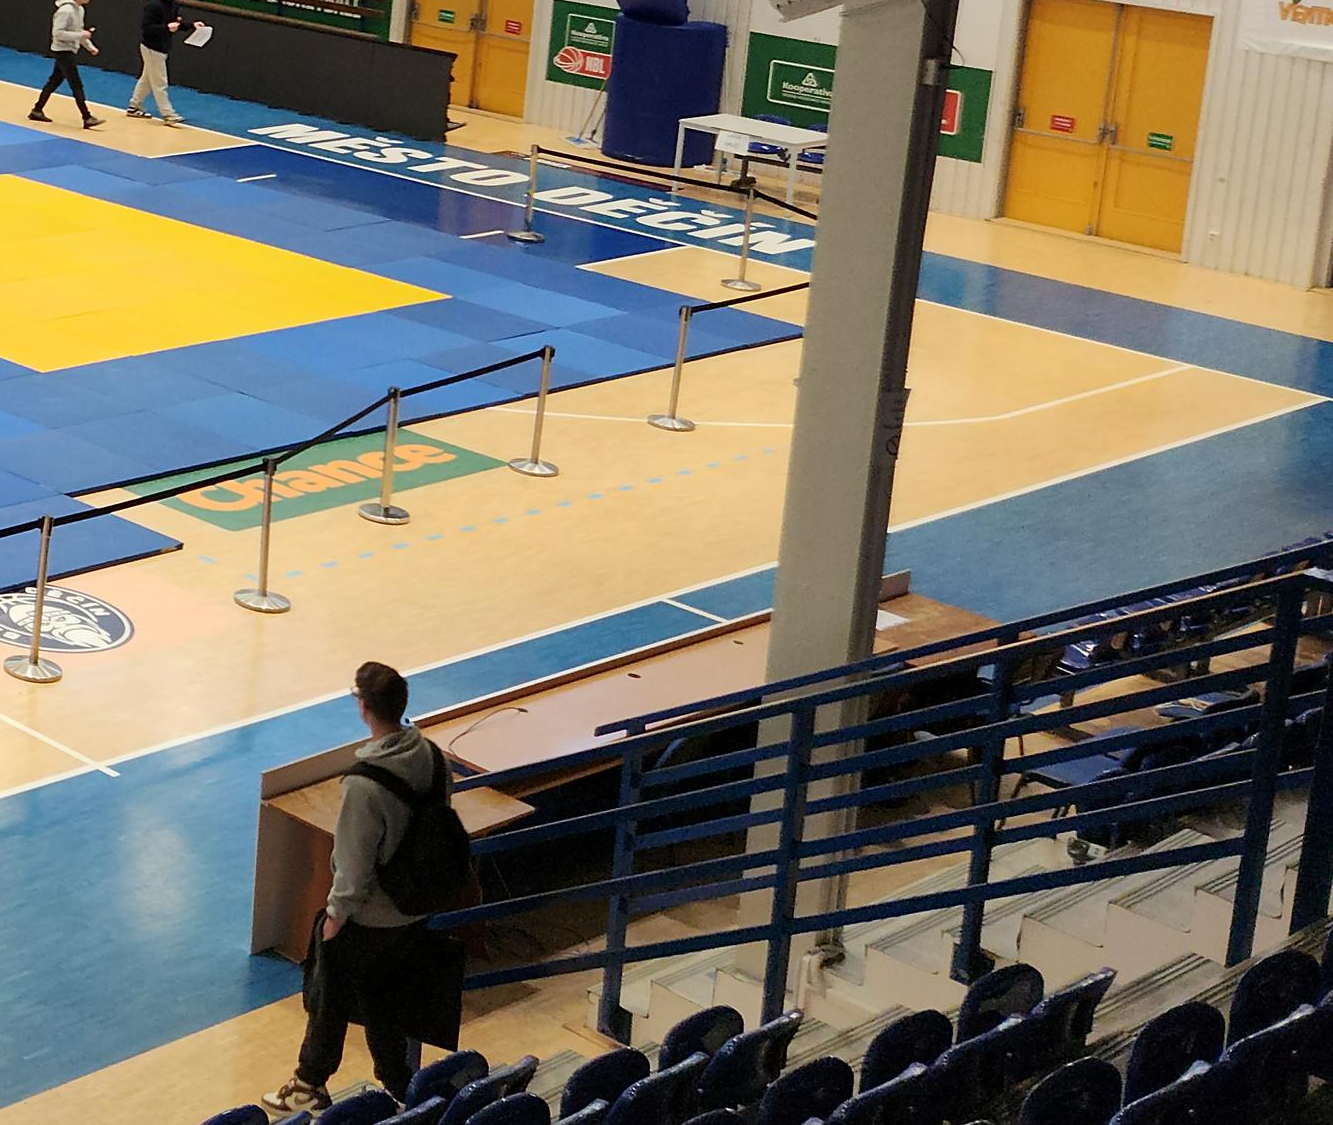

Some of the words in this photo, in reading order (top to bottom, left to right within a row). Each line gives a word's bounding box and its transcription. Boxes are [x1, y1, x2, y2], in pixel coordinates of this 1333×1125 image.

[247, 123, 531, 187] MĚSTO
[533, 184, 817, 256] DĚČÍN
[177, 444, 457, 512] Chance
